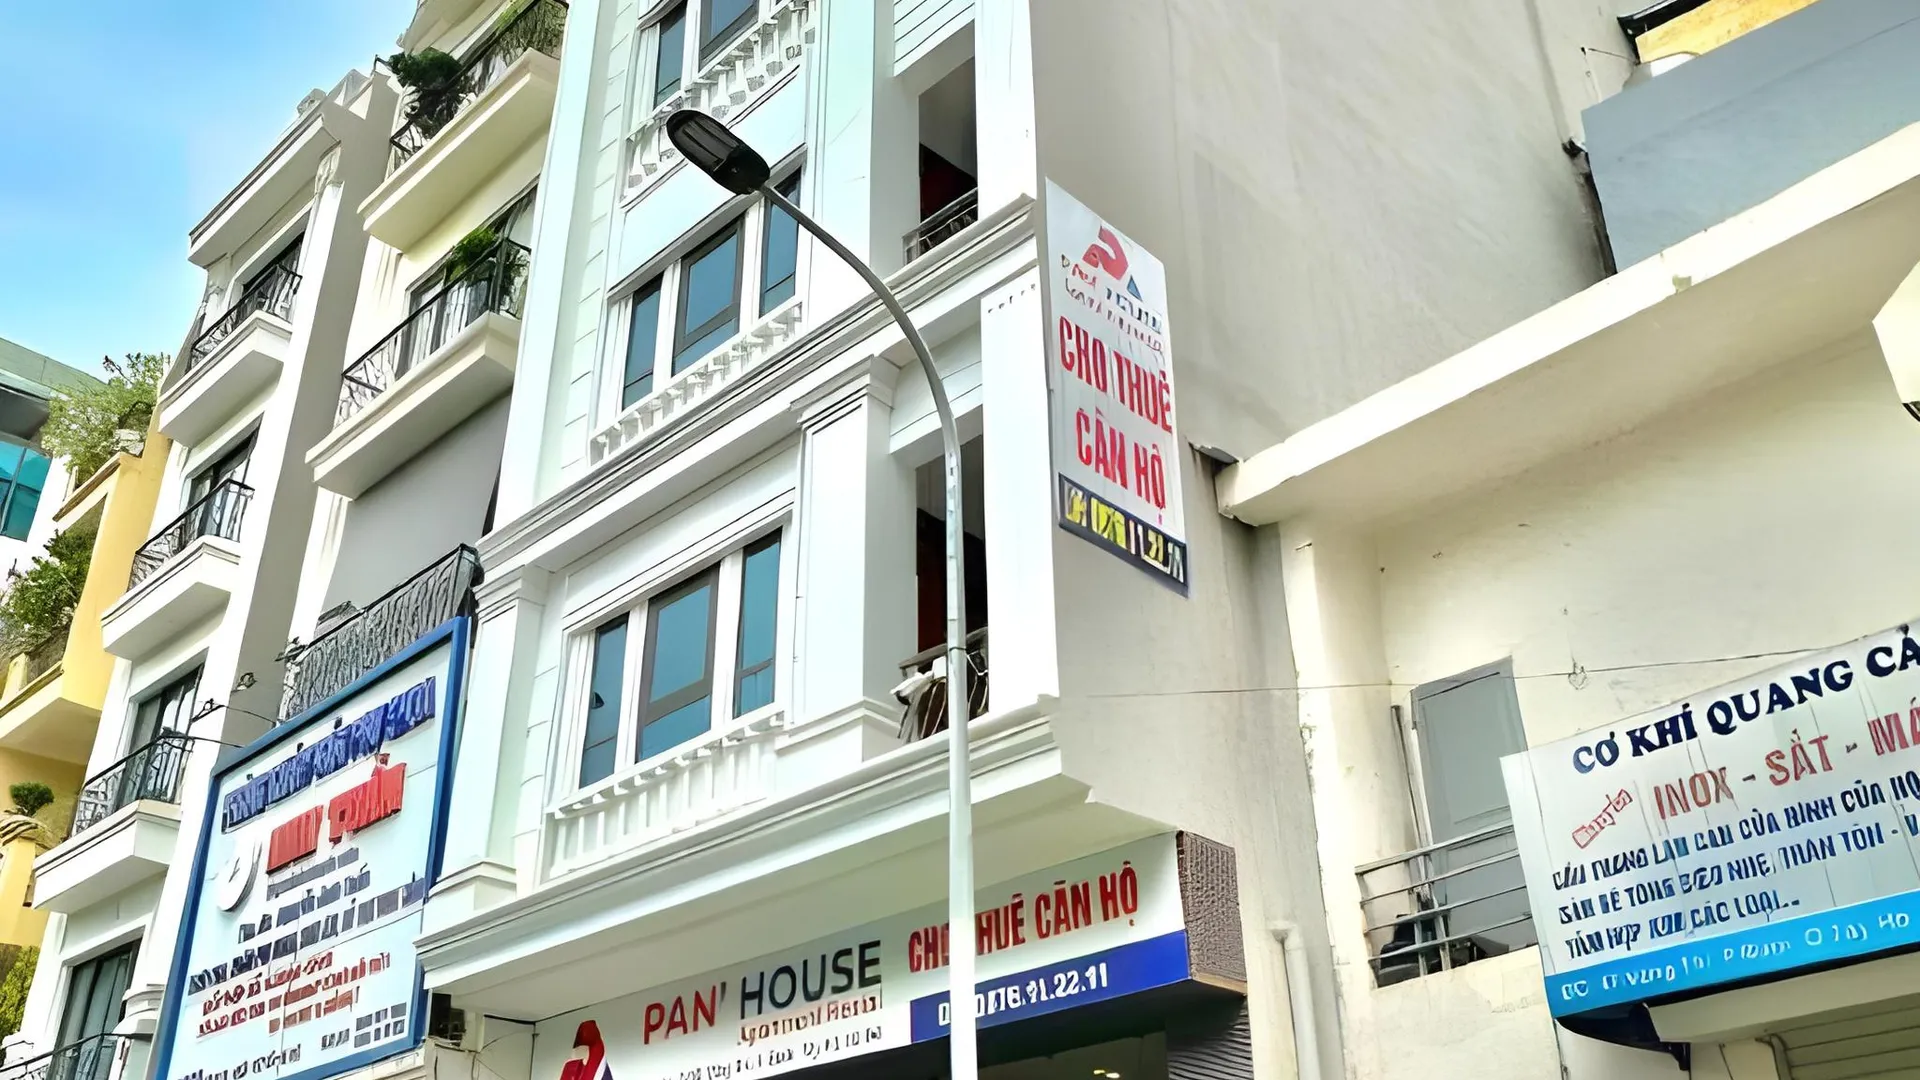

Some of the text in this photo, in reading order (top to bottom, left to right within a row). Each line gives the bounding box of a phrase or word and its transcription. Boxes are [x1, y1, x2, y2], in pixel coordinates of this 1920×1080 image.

[1059, 315, 1108, 394] CHO
[1113, 349, 1173, 434] THUÊ
[1134, 442, 1167, 526] HỘ
[1572, 731, 1620, 775] CƠ
[1626, 702, 1699, 758] KHÍ
[1706, 659, 1855, 736] QUANG
[1652, 765, 1735, 821] INOX
[739, 939, 883, 1020] HOUSE
[975, 892, 1026, 957] HUÊ
[1034, 879, 1092, 940] CĂN
[1098, 859, 1138, 928] HỘ
